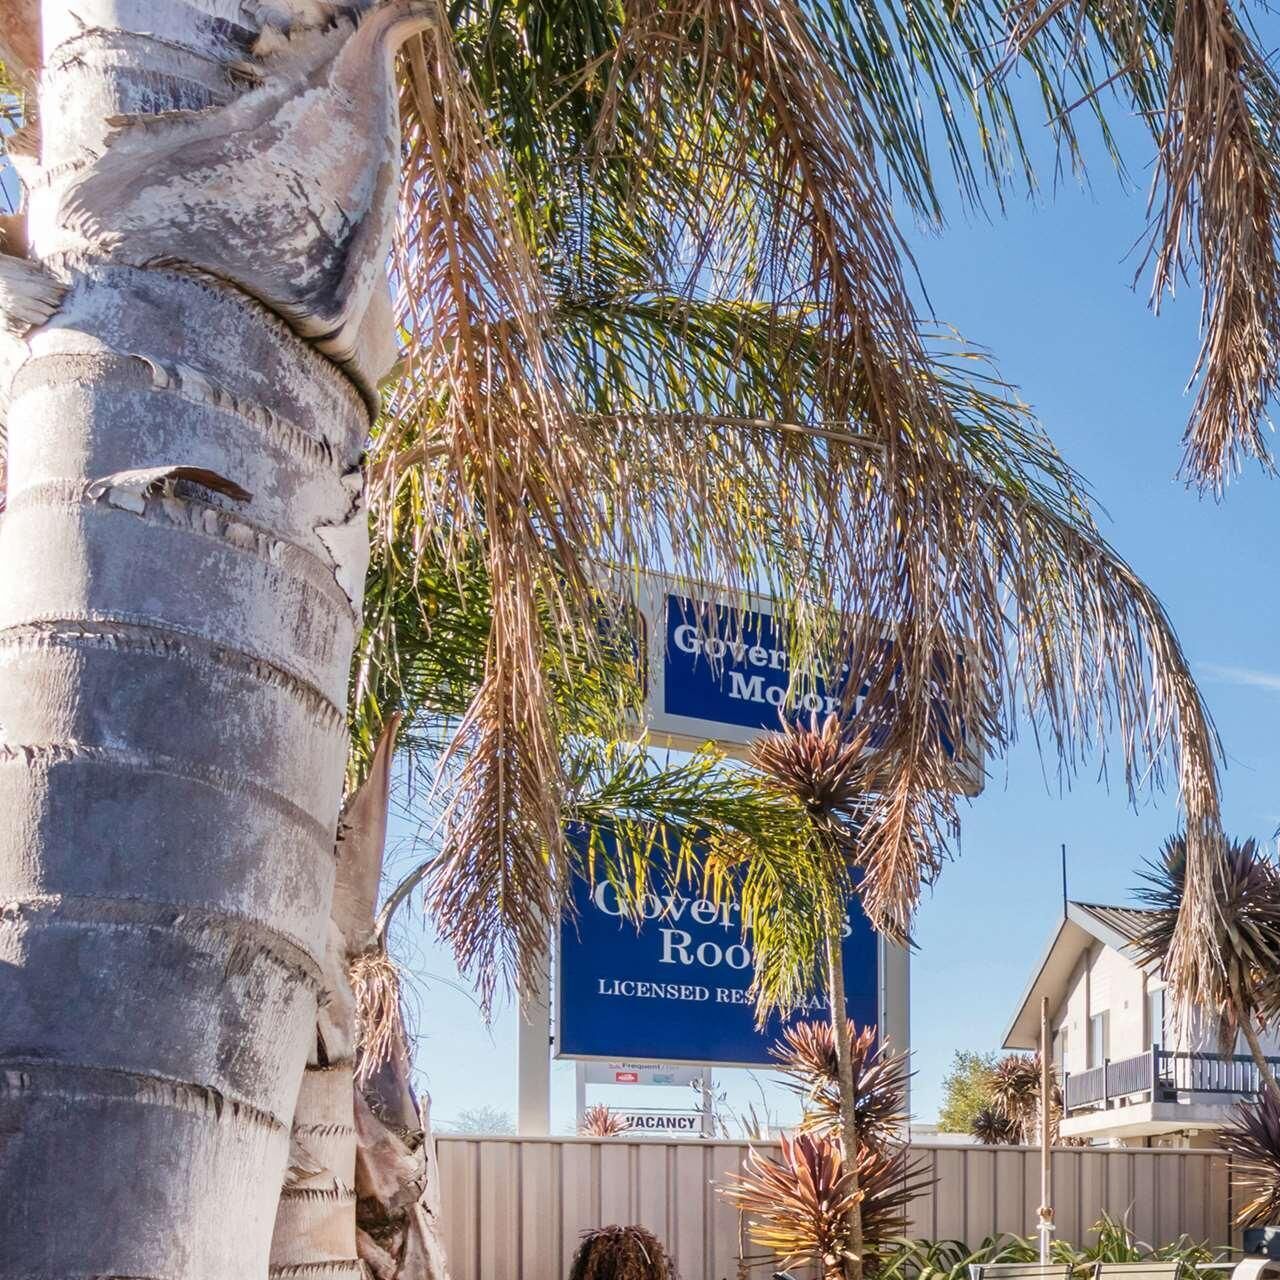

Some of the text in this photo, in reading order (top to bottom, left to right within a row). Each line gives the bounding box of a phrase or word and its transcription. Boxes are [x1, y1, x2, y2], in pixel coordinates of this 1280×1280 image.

[594, 879, 853, 938] Govers
[658, 927, 788, 971] Roo
[598, 978, 710, 1001] LICENSED
[626, 1116, 696, 1130] VACANCY
